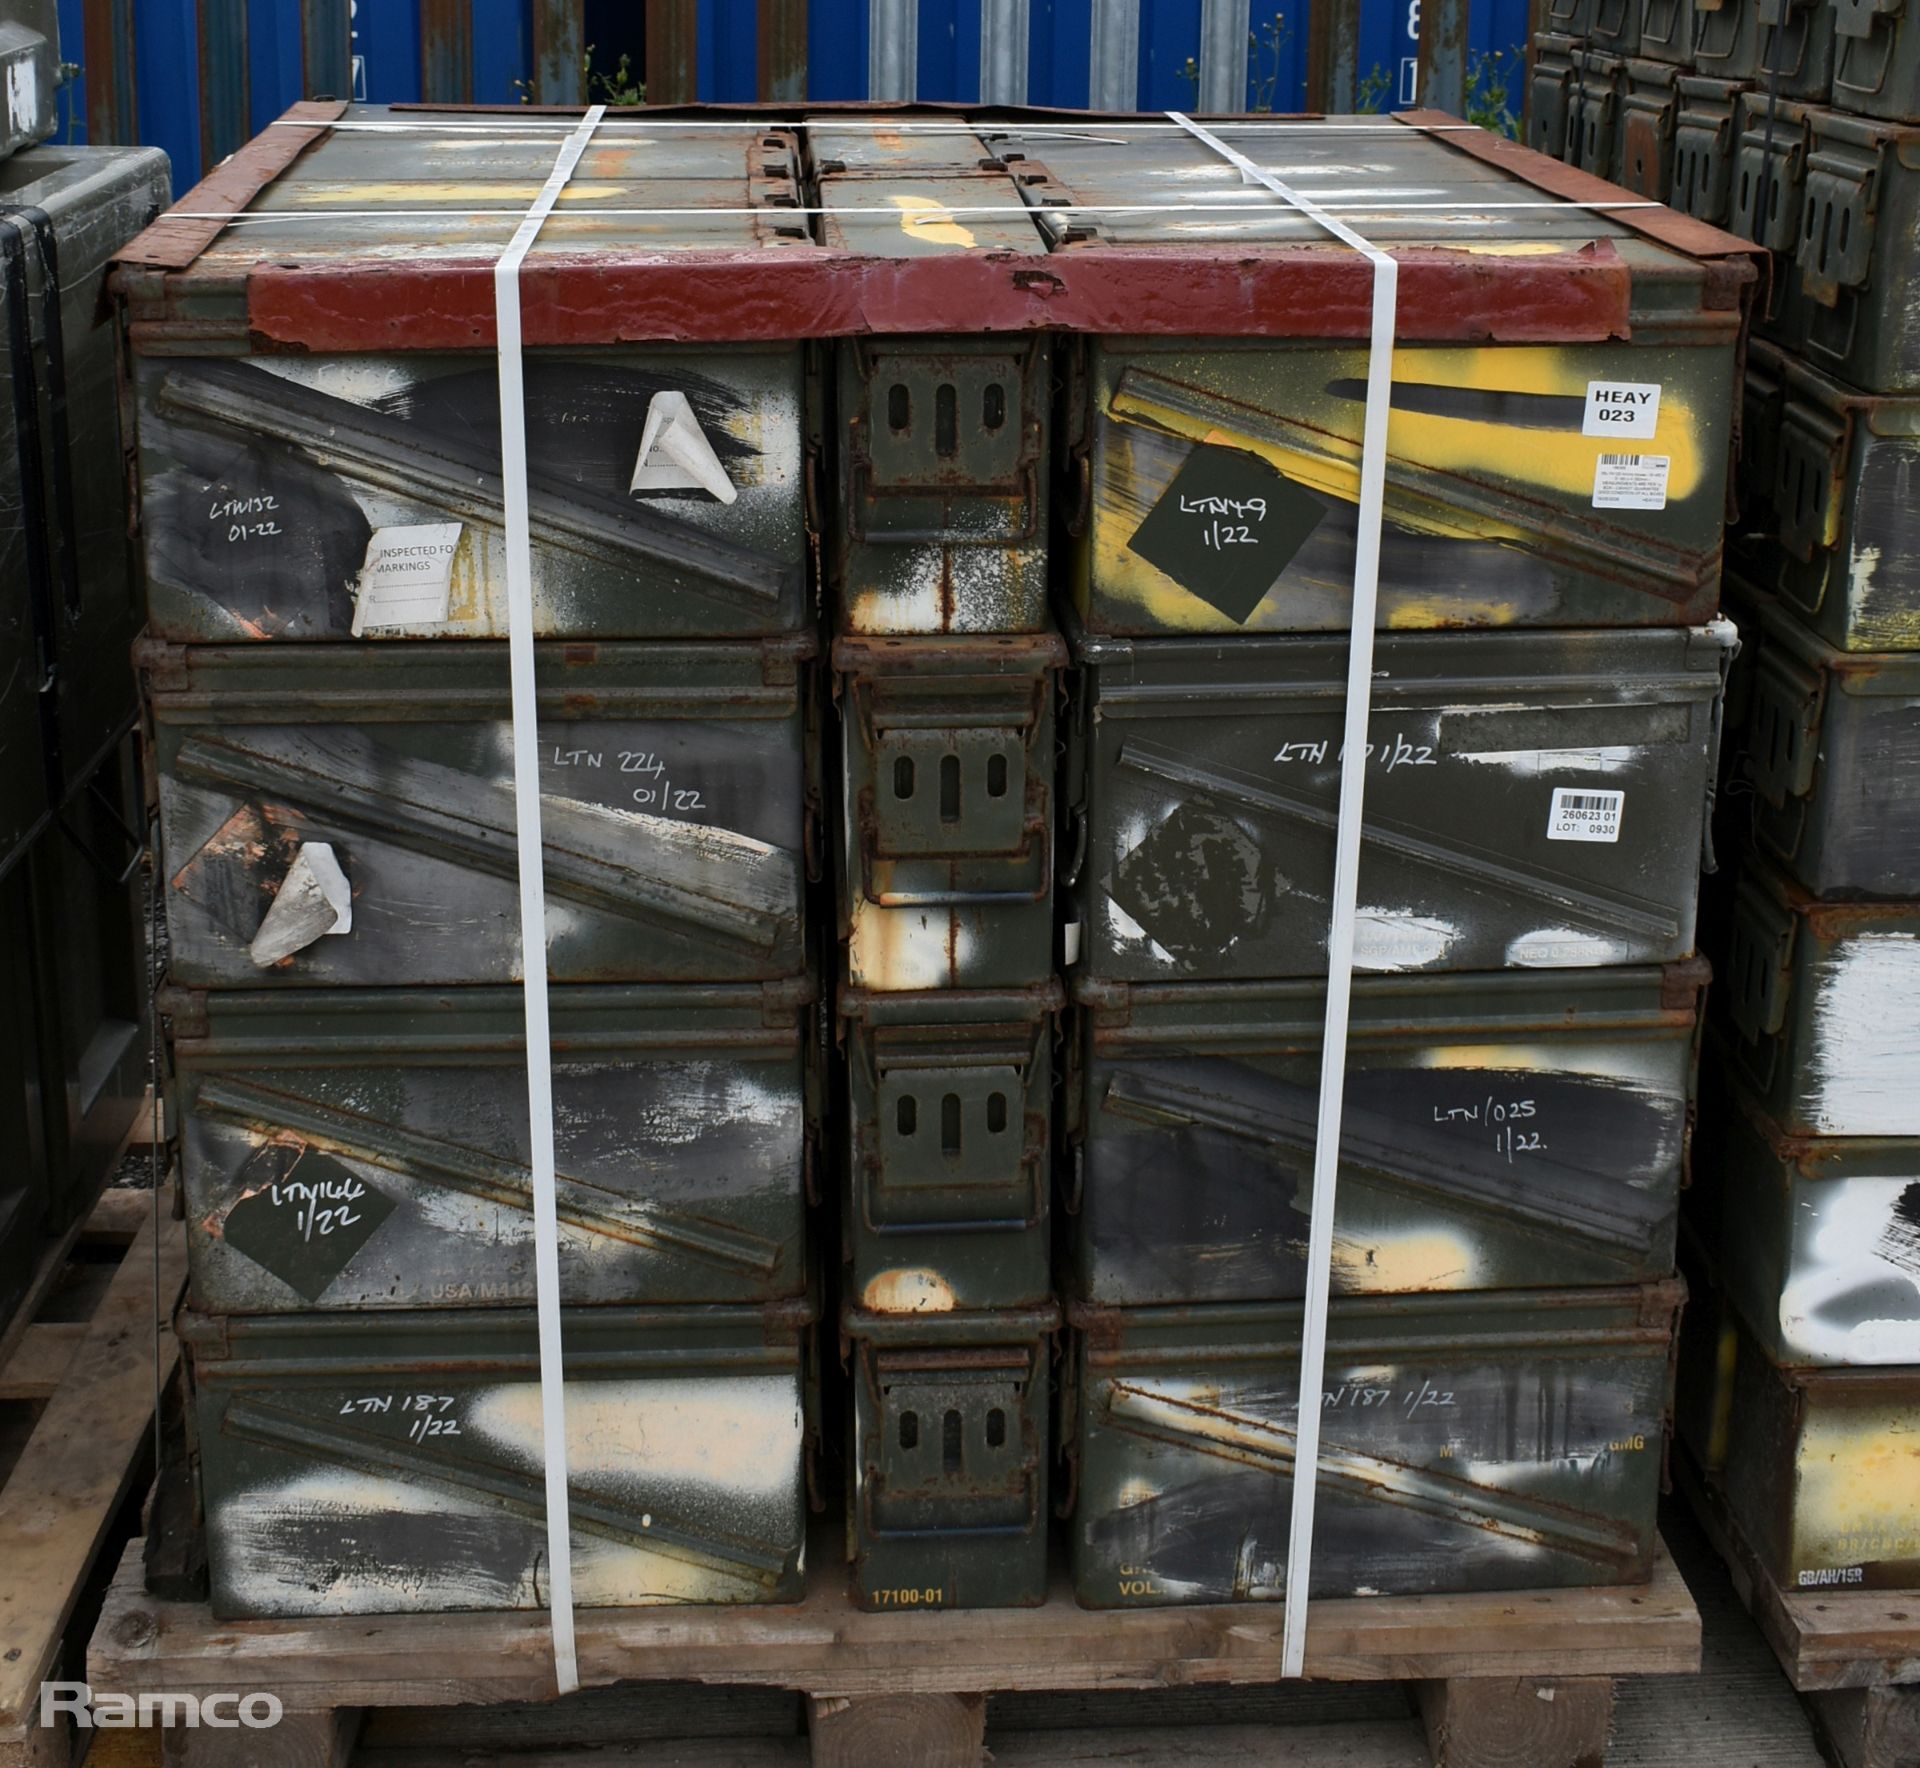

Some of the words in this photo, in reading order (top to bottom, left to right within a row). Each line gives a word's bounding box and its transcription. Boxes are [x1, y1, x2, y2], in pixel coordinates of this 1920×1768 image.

[1595, 390, 1651, 405] HEAY
[1599, 408, 1635, 423] 023
[228, 521, 283, 542] 01-22
[1204, 520, 1259, 551] 1/22
[380, 545, 437, 558] INSPECTED
[554, 746, 603, 769] LTN
[617, 751, 666, 780] 224
[1273, 740, 1329, 766] LTN
[1380, 732, 1438, 774] 1/22
[633, 780, 707, 811] 01/22
[1562, 810, 1601, 821] 260623
[1604, 812, 1617, 822] 01
[1589, 824, 1616, 835] 0930
[1434, 1096, 1537, 1127] LTN/025
[297, 1197, 362, 1242] 1/22
[340, 1395, 393, 1415] LTN
[401, 1395, 455, 1412] 187
[1350, 1388, 1391, 1408] 187
[1403, 1380, 1457, 1419] 1/22
[409, 1414, 461, 1446] 1/22
[872, 1588, 943, 1605] 17100-01
